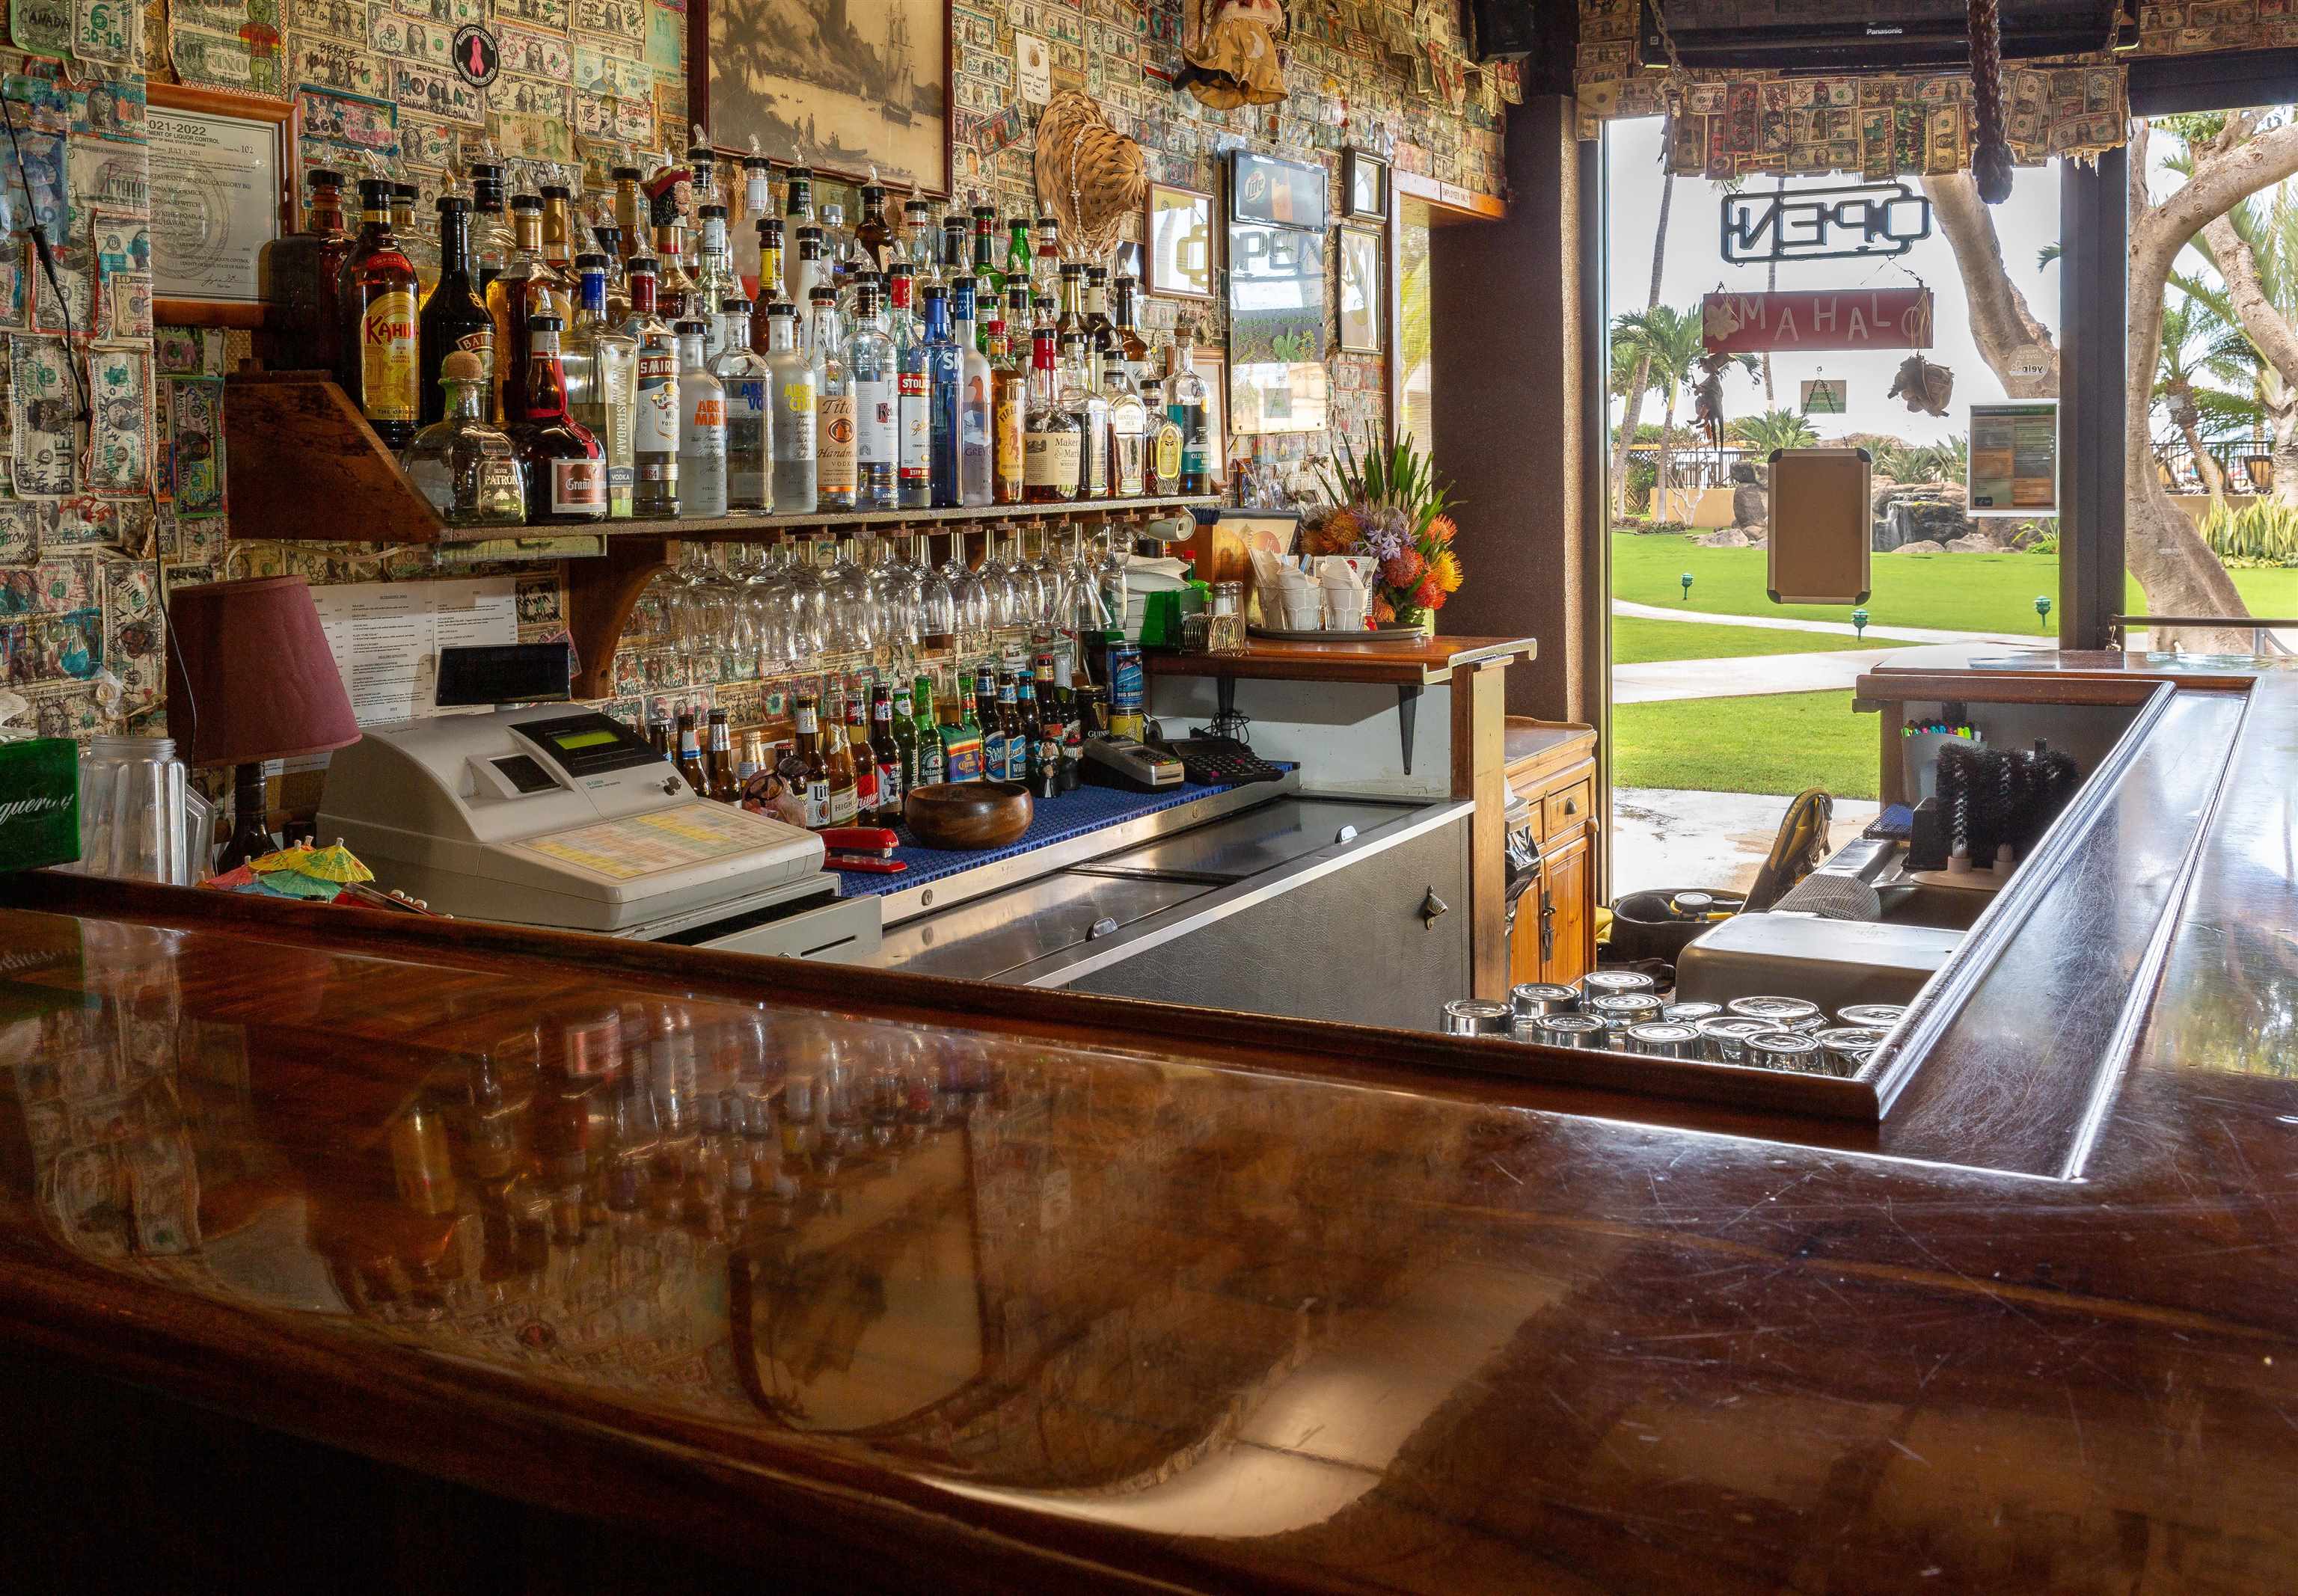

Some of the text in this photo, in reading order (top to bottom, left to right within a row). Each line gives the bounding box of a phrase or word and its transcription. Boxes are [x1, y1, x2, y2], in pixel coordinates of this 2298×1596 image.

[165, 131, 173, 139] OF
[174, 132, 194, 141] LIQUOR
[194, 135, 221, 144] CONTROL
[168, 144, 183, 155] JULY
[241, 145, 254, 154] 102
[1739, 293, 1925, 342] MAHALO
[616, 390, 628, 458] AMSTERDAM
[965, 447, 986, 456] GREY
[485, 473, 518, 485] PATRÓN
[834, 801, 853, 812] HIGH
